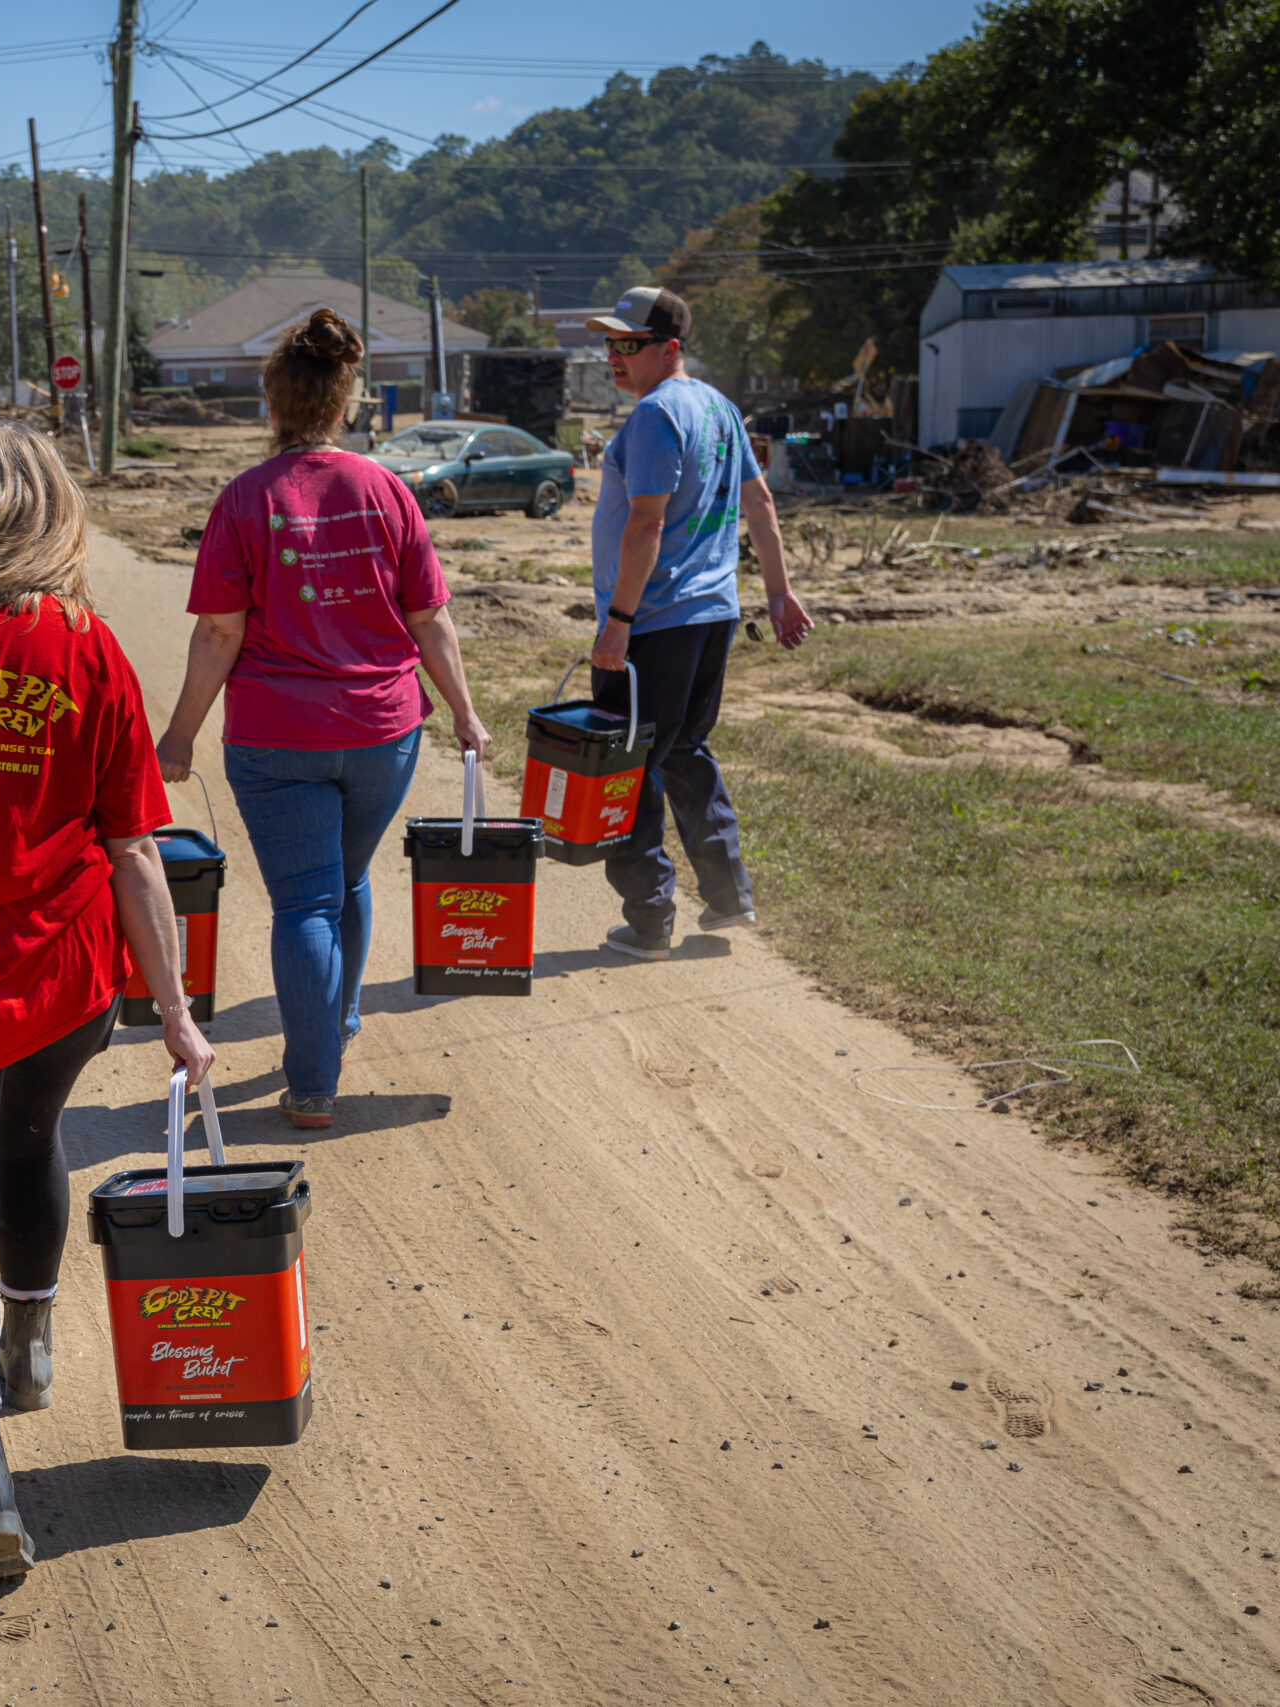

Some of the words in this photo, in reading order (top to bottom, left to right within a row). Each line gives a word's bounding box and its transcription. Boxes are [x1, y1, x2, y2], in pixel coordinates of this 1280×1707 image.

[53, 366, 80, 380] STOP
[323, 586, 345, 599] 安全
[353, 587, 376, 596] Safety
[10, 674, 81, 723] PIT
[29, 745, 56, 757] TEAM
[441, 923, 485, 940] Blessing
[461, 935, 505, 951] Bucket
[201, 1288, 248, 1311] PIT
[171, 1306, 224, 1323] CREW
[150, 1341, 215, 1364] Blessing
[181, 1356, 245, 1379] Bucket
[124, 1410, 153, 1422] people
[155, 1411, 166, 1419] in
[168, 1408, 195, 1420] times
[199, 1410, 210, 1421] of
[215, 1410, 248, 1419] crisis.
